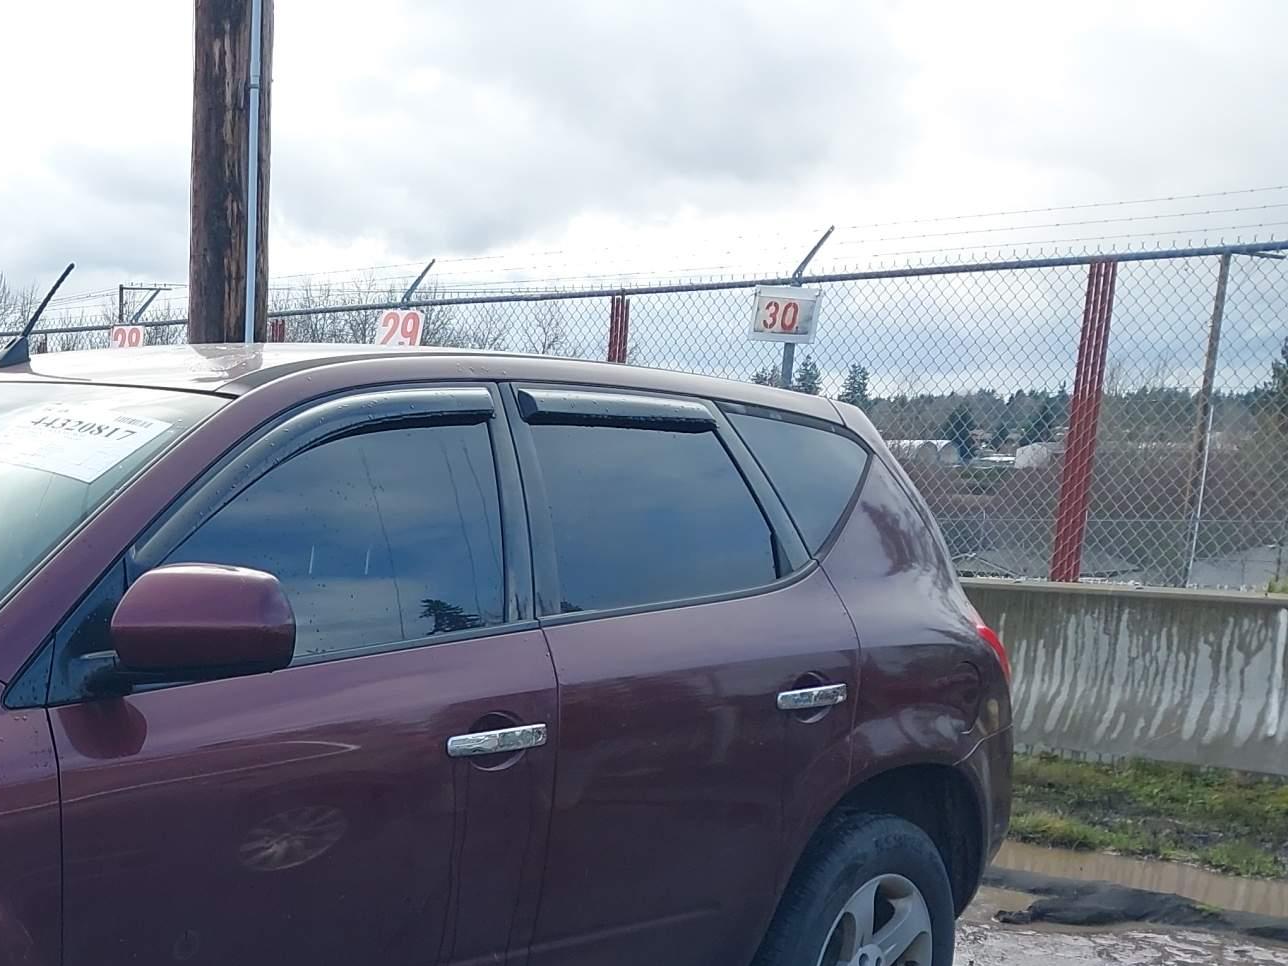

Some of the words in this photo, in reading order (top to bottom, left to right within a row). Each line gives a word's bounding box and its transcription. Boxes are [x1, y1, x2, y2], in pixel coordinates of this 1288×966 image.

[380, 312, 420, 346] 29
[763, 301, 799, 331] 30
[31, 415, 137, 441] 44320817
